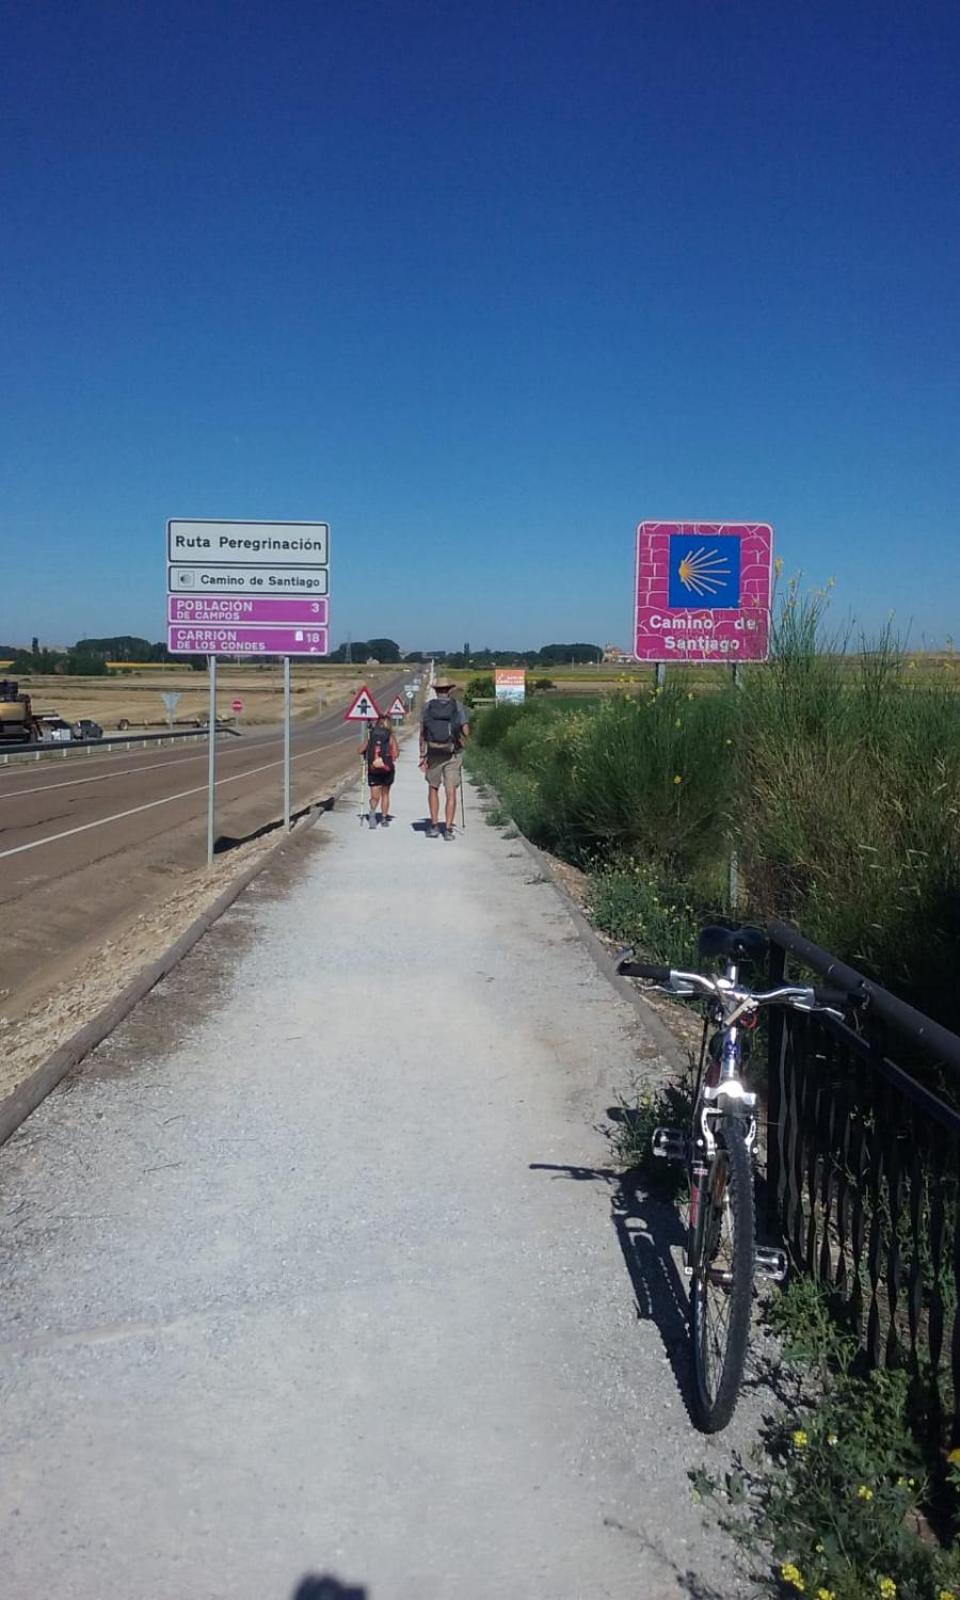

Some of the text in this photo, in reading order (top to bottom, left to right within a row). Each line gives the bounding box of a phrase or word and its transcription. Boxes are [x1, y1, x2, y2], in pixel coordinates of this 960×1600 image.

[175, 535, 322, 551] Ruta Peregrinación
[200, 575, 320, 588] Camino de Santiago
[311, 603, 320, 613] 3
[176, 611, 240, 621] DE CAMPOS
[649, 615, 756, 630] Camino de
[306, 633, 320, 643] 18
[176, 641, 266, 651] DE LOS CONDES
[664, 636, 740, 652] Santiago
